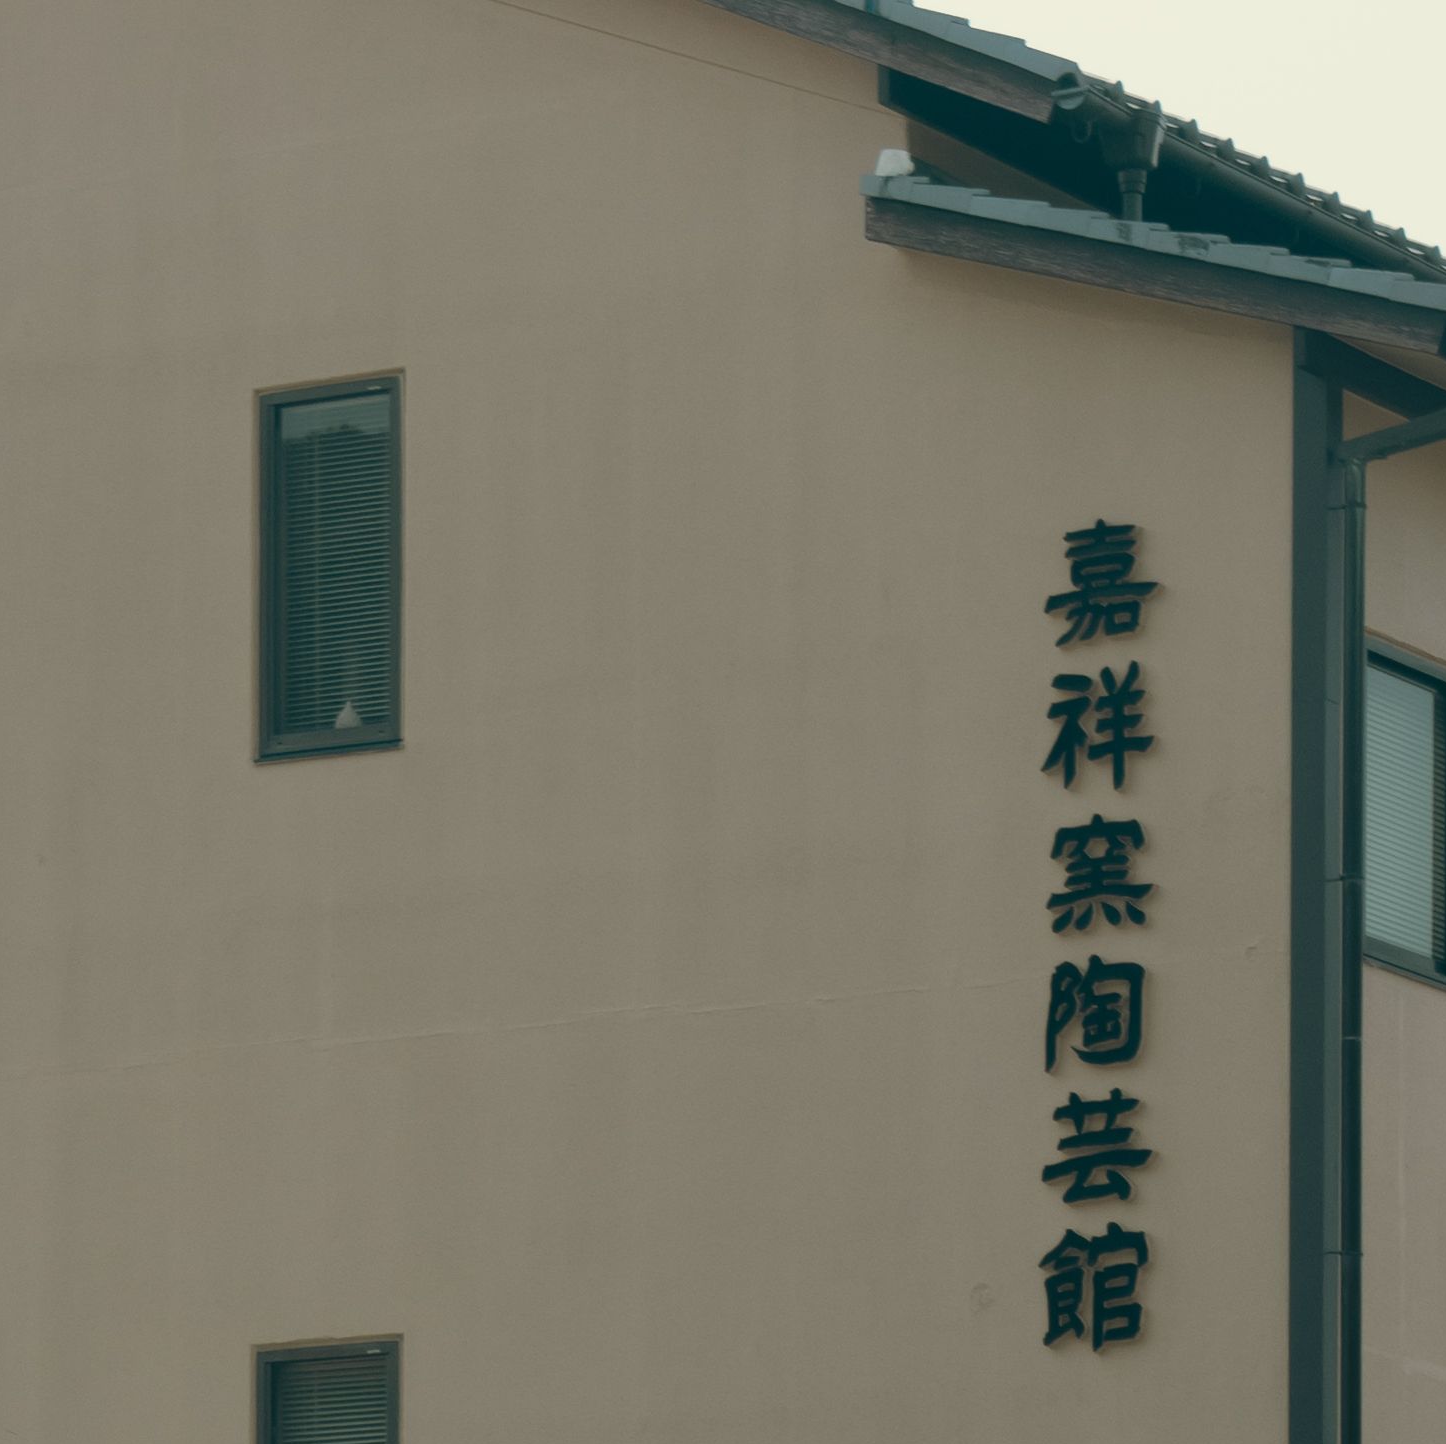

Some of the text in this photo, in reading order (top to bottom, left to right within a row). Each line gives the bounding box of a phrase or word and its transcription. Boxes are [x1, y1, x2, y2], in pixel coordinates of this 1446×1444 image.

[1041, 518, 1159, 1352] 嘉祥窯陶芸館
